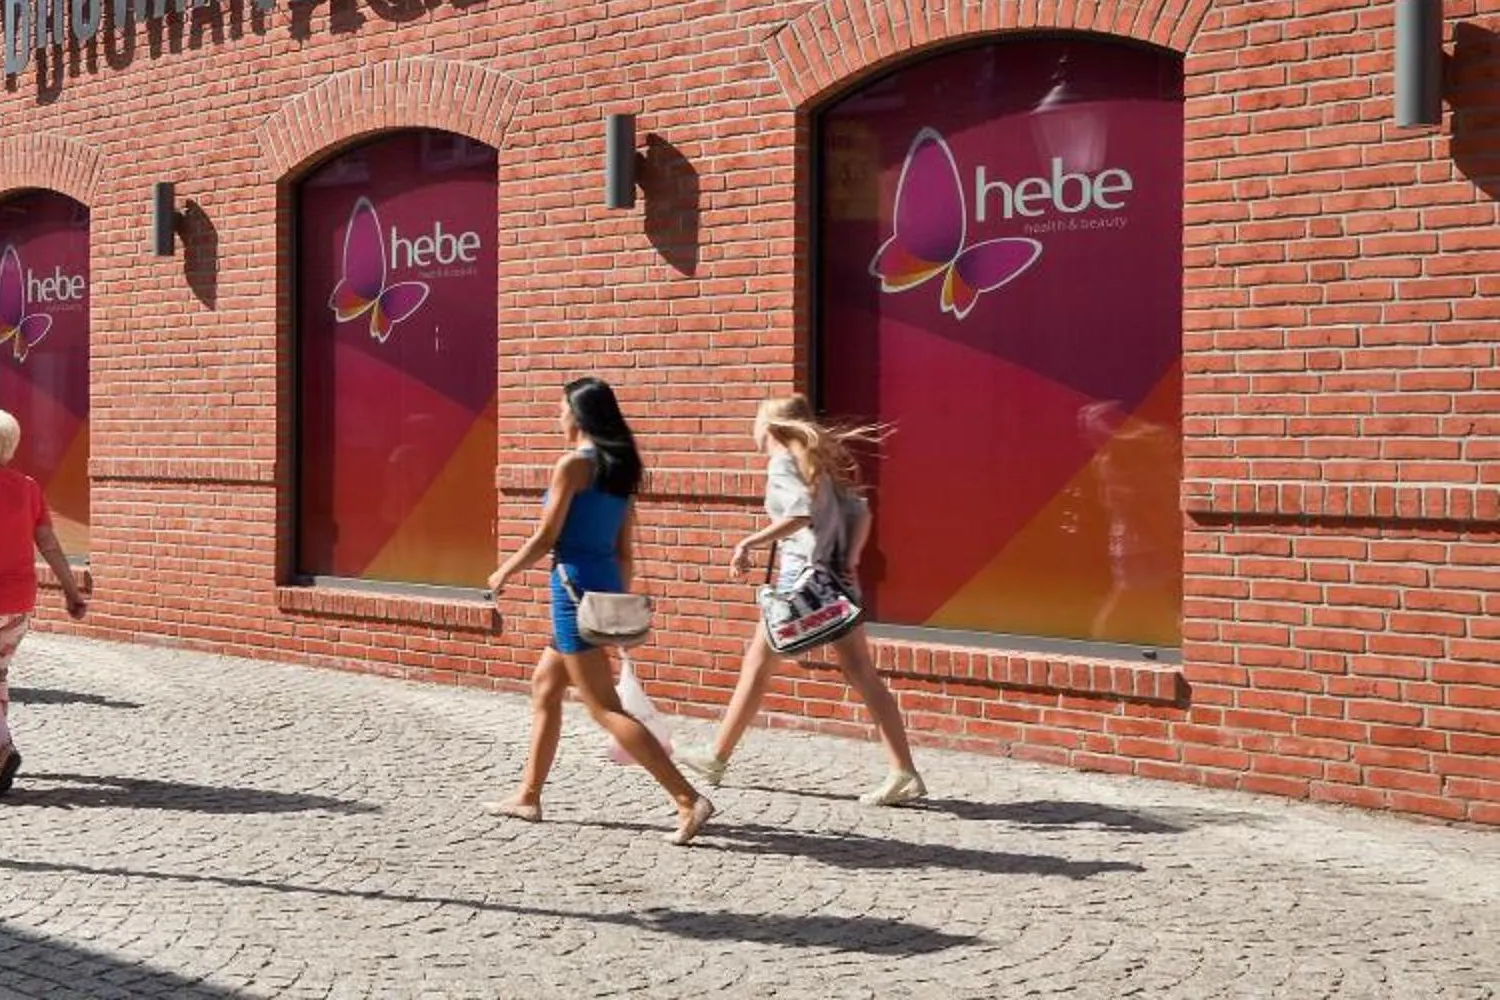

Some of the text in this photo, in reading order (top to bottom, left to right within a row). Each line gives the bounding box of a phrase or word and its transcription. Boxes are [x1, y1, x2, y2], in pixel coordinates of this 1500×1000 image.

[975, 157, 1133, 222] hebe
[391, 221, 481, 269] hebe
[27, 264, 85, 304] hebe
